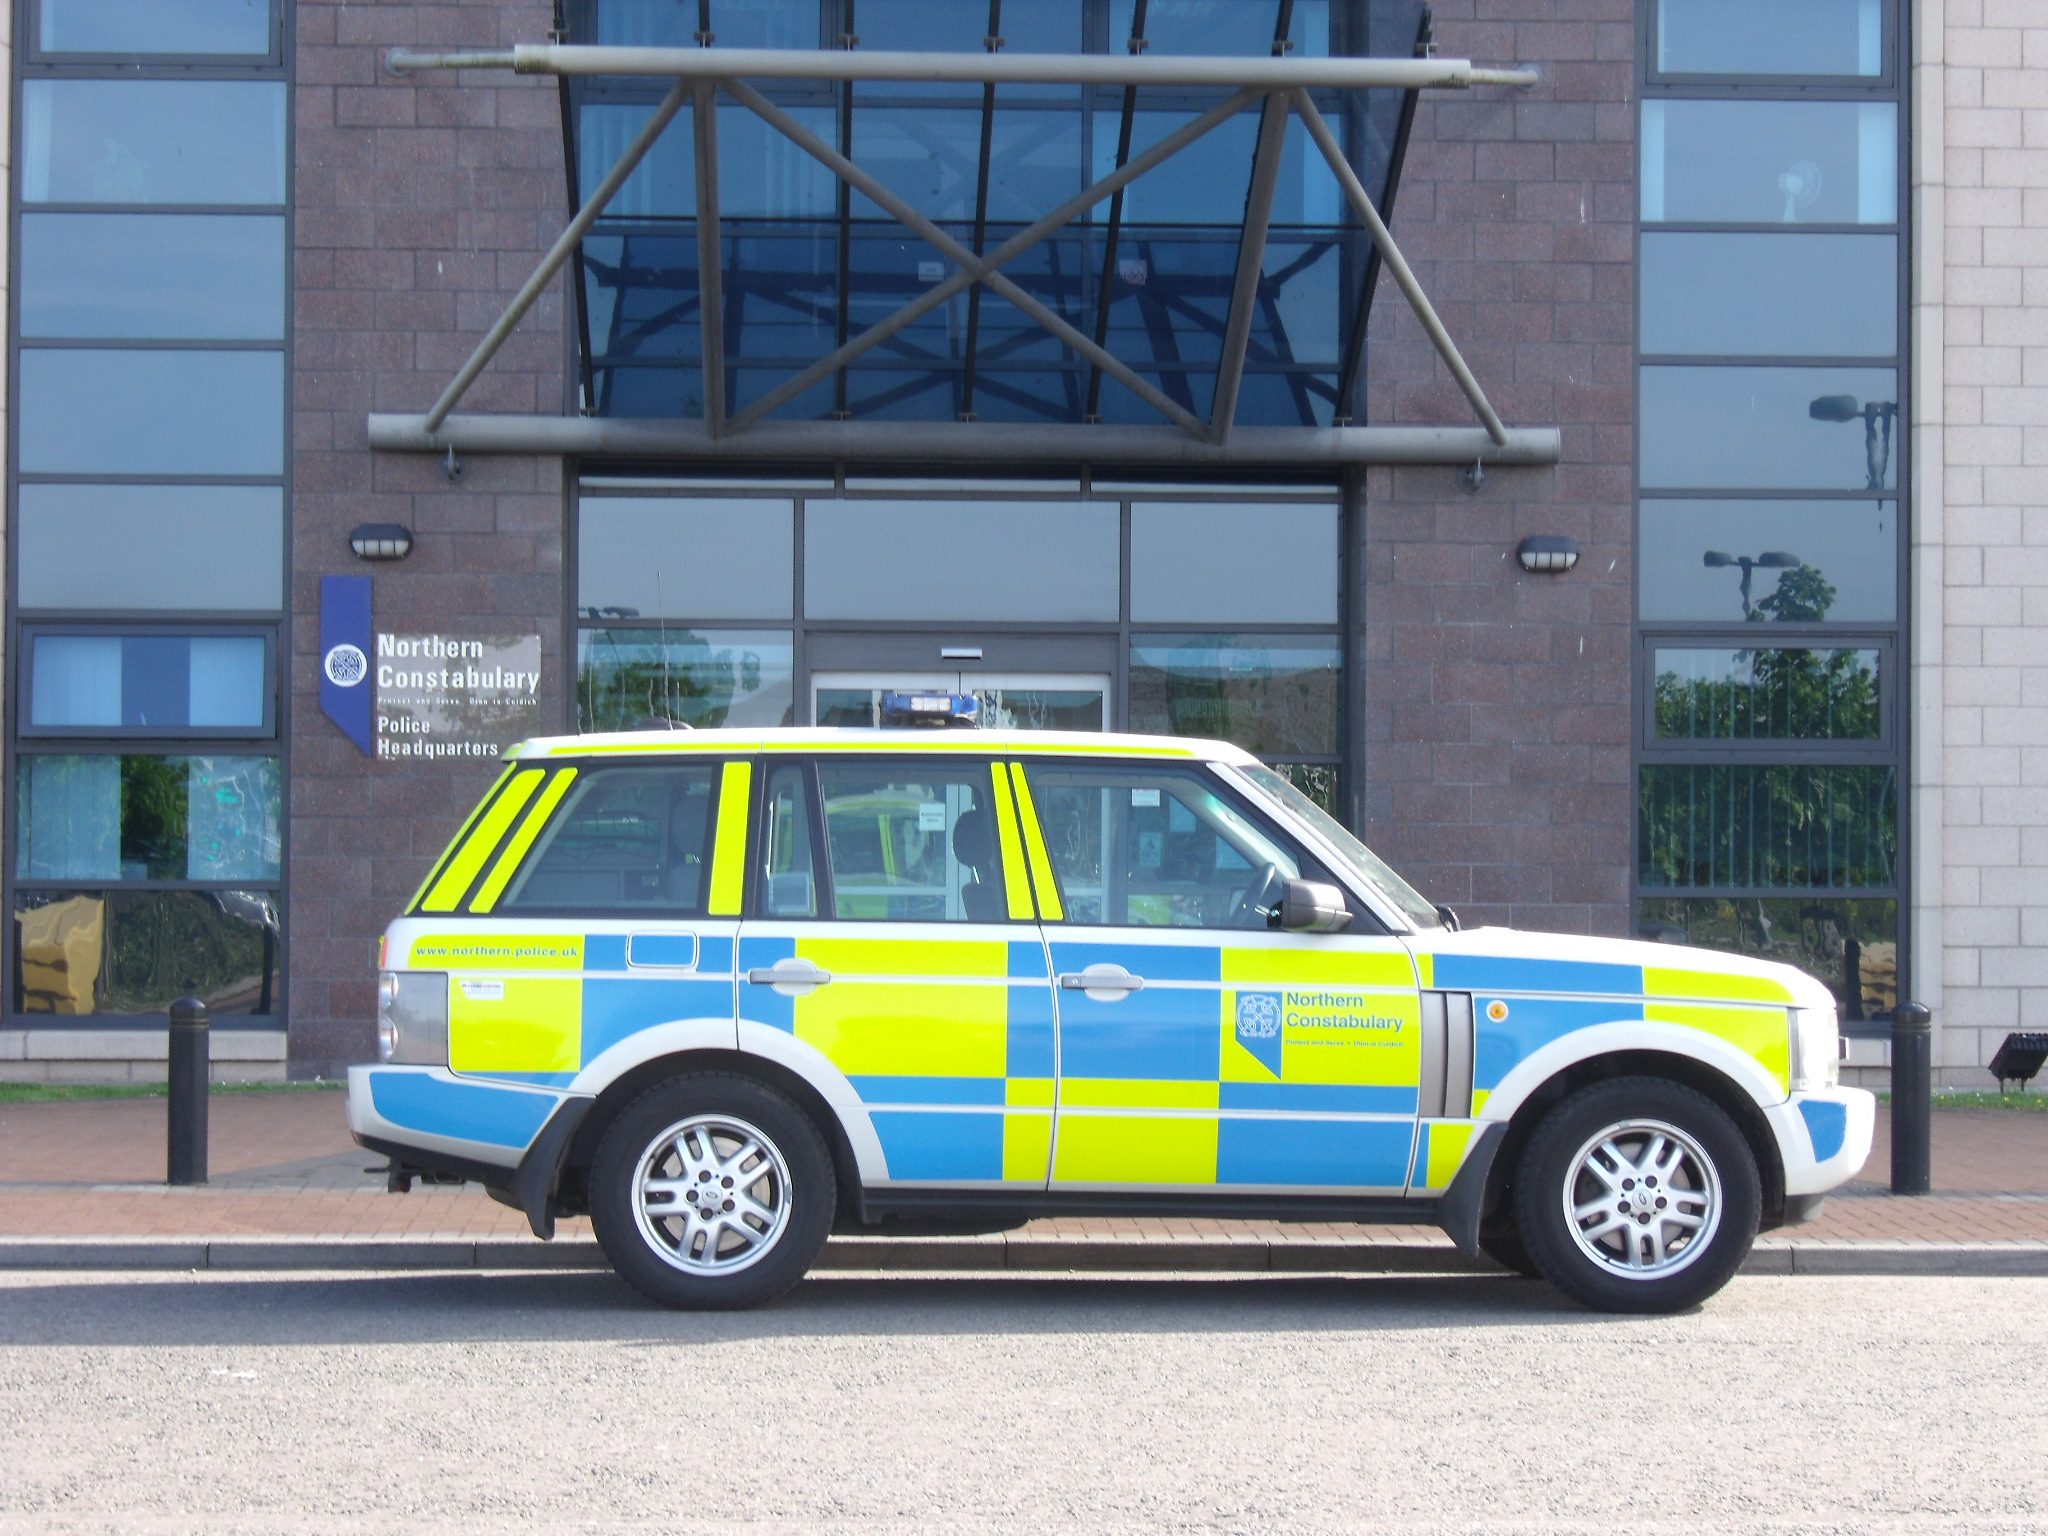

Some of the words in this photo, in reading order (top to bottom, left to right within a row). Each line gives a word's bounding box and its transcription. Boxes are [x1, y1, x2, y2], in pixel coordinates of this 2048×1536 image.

[377, 633, 483, 658] Northern
[377, 665, 540, 694] Constabulary
[377, 716, 430, 734] Police
[377, 738, 499, 760] Headquarters
[416, 945, 578, 958] www.northern.police.uk
[1286, 992, 1363, 1008] Northern
[1286, 1012, 1404, 1033] Constabulary
